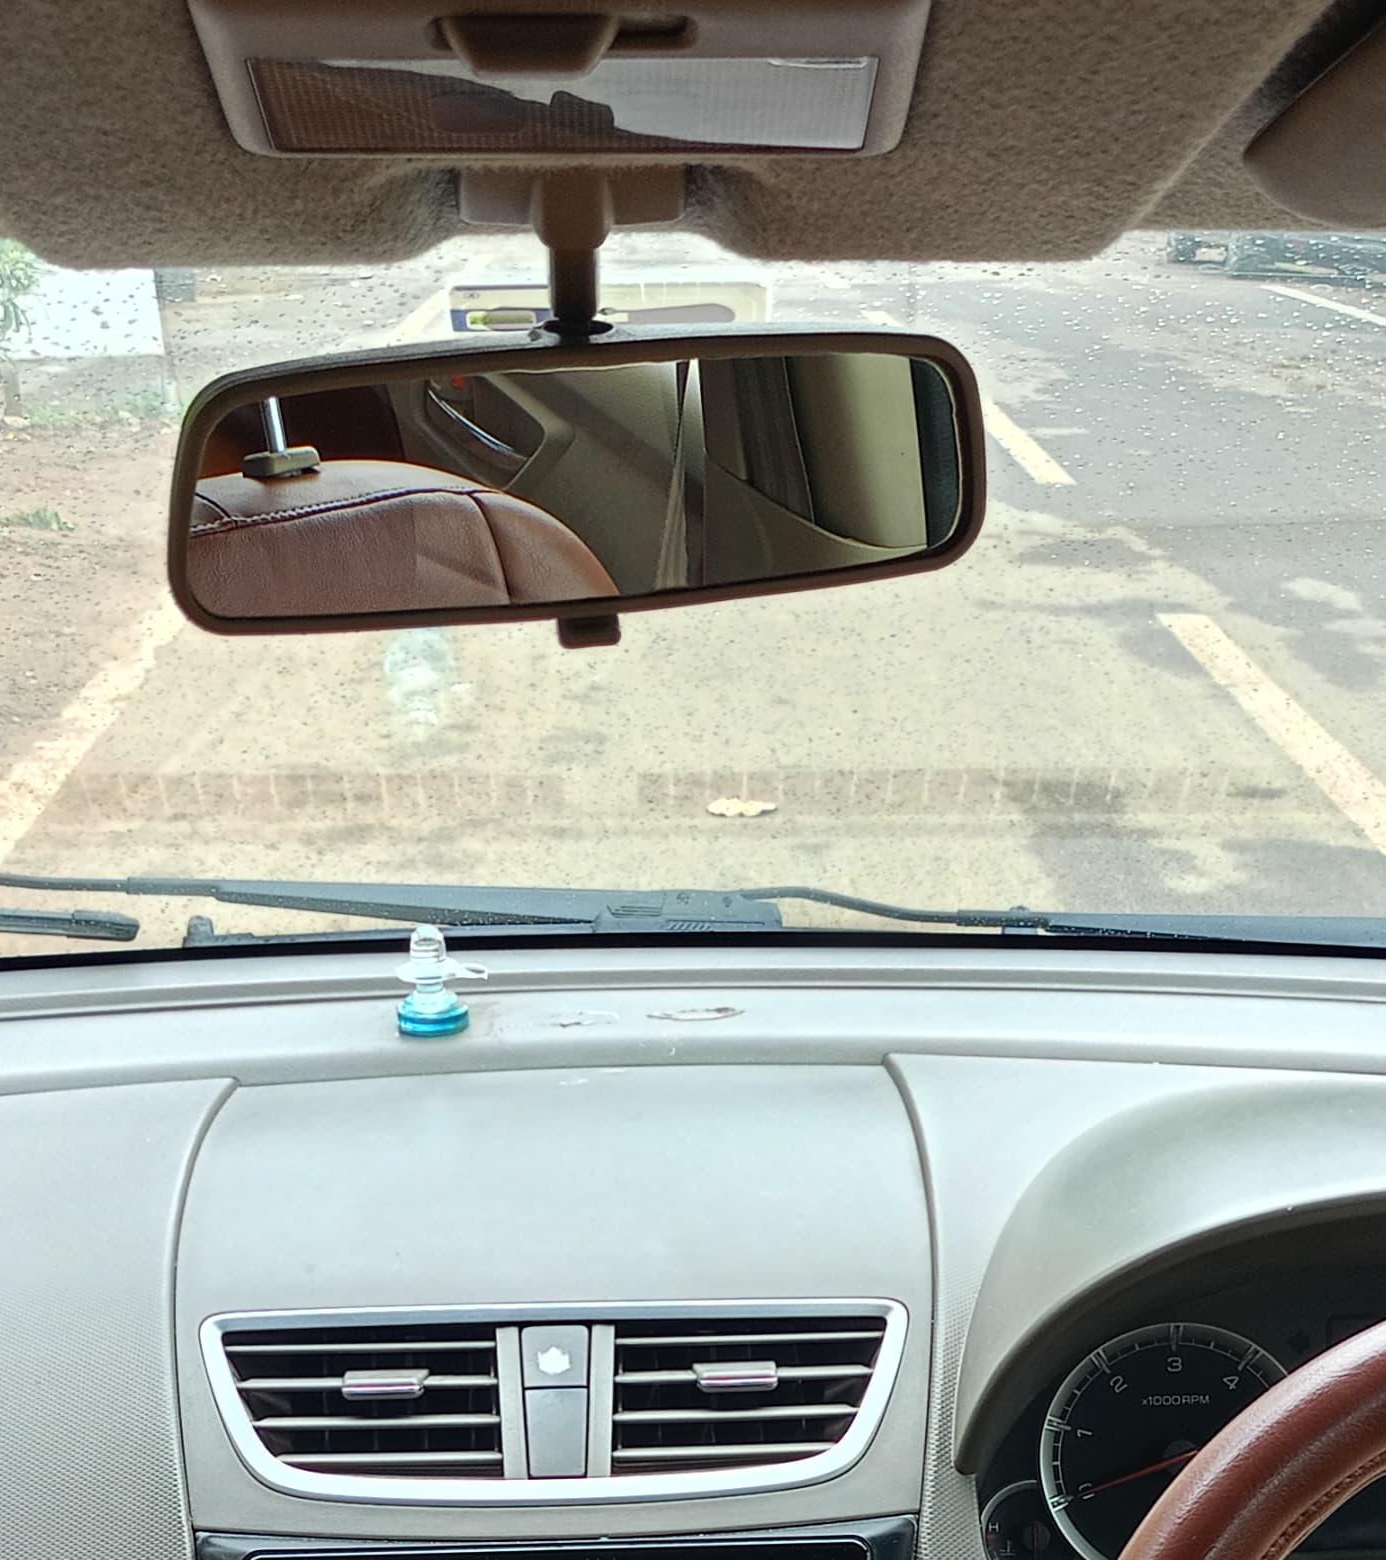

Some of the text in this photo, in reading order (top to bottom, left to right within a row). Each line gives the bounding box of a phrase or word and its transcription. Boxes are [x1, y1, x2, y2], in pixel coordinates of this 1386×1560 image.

[1167, 1357, 1182, 1372] 3
[1110, 1375, 1128, 1393] 2
[1223, 1375, 1239, 1390] 4
[1077, 1428, 1093, 1437] 1
[988, 1522, 999, 1532] H
